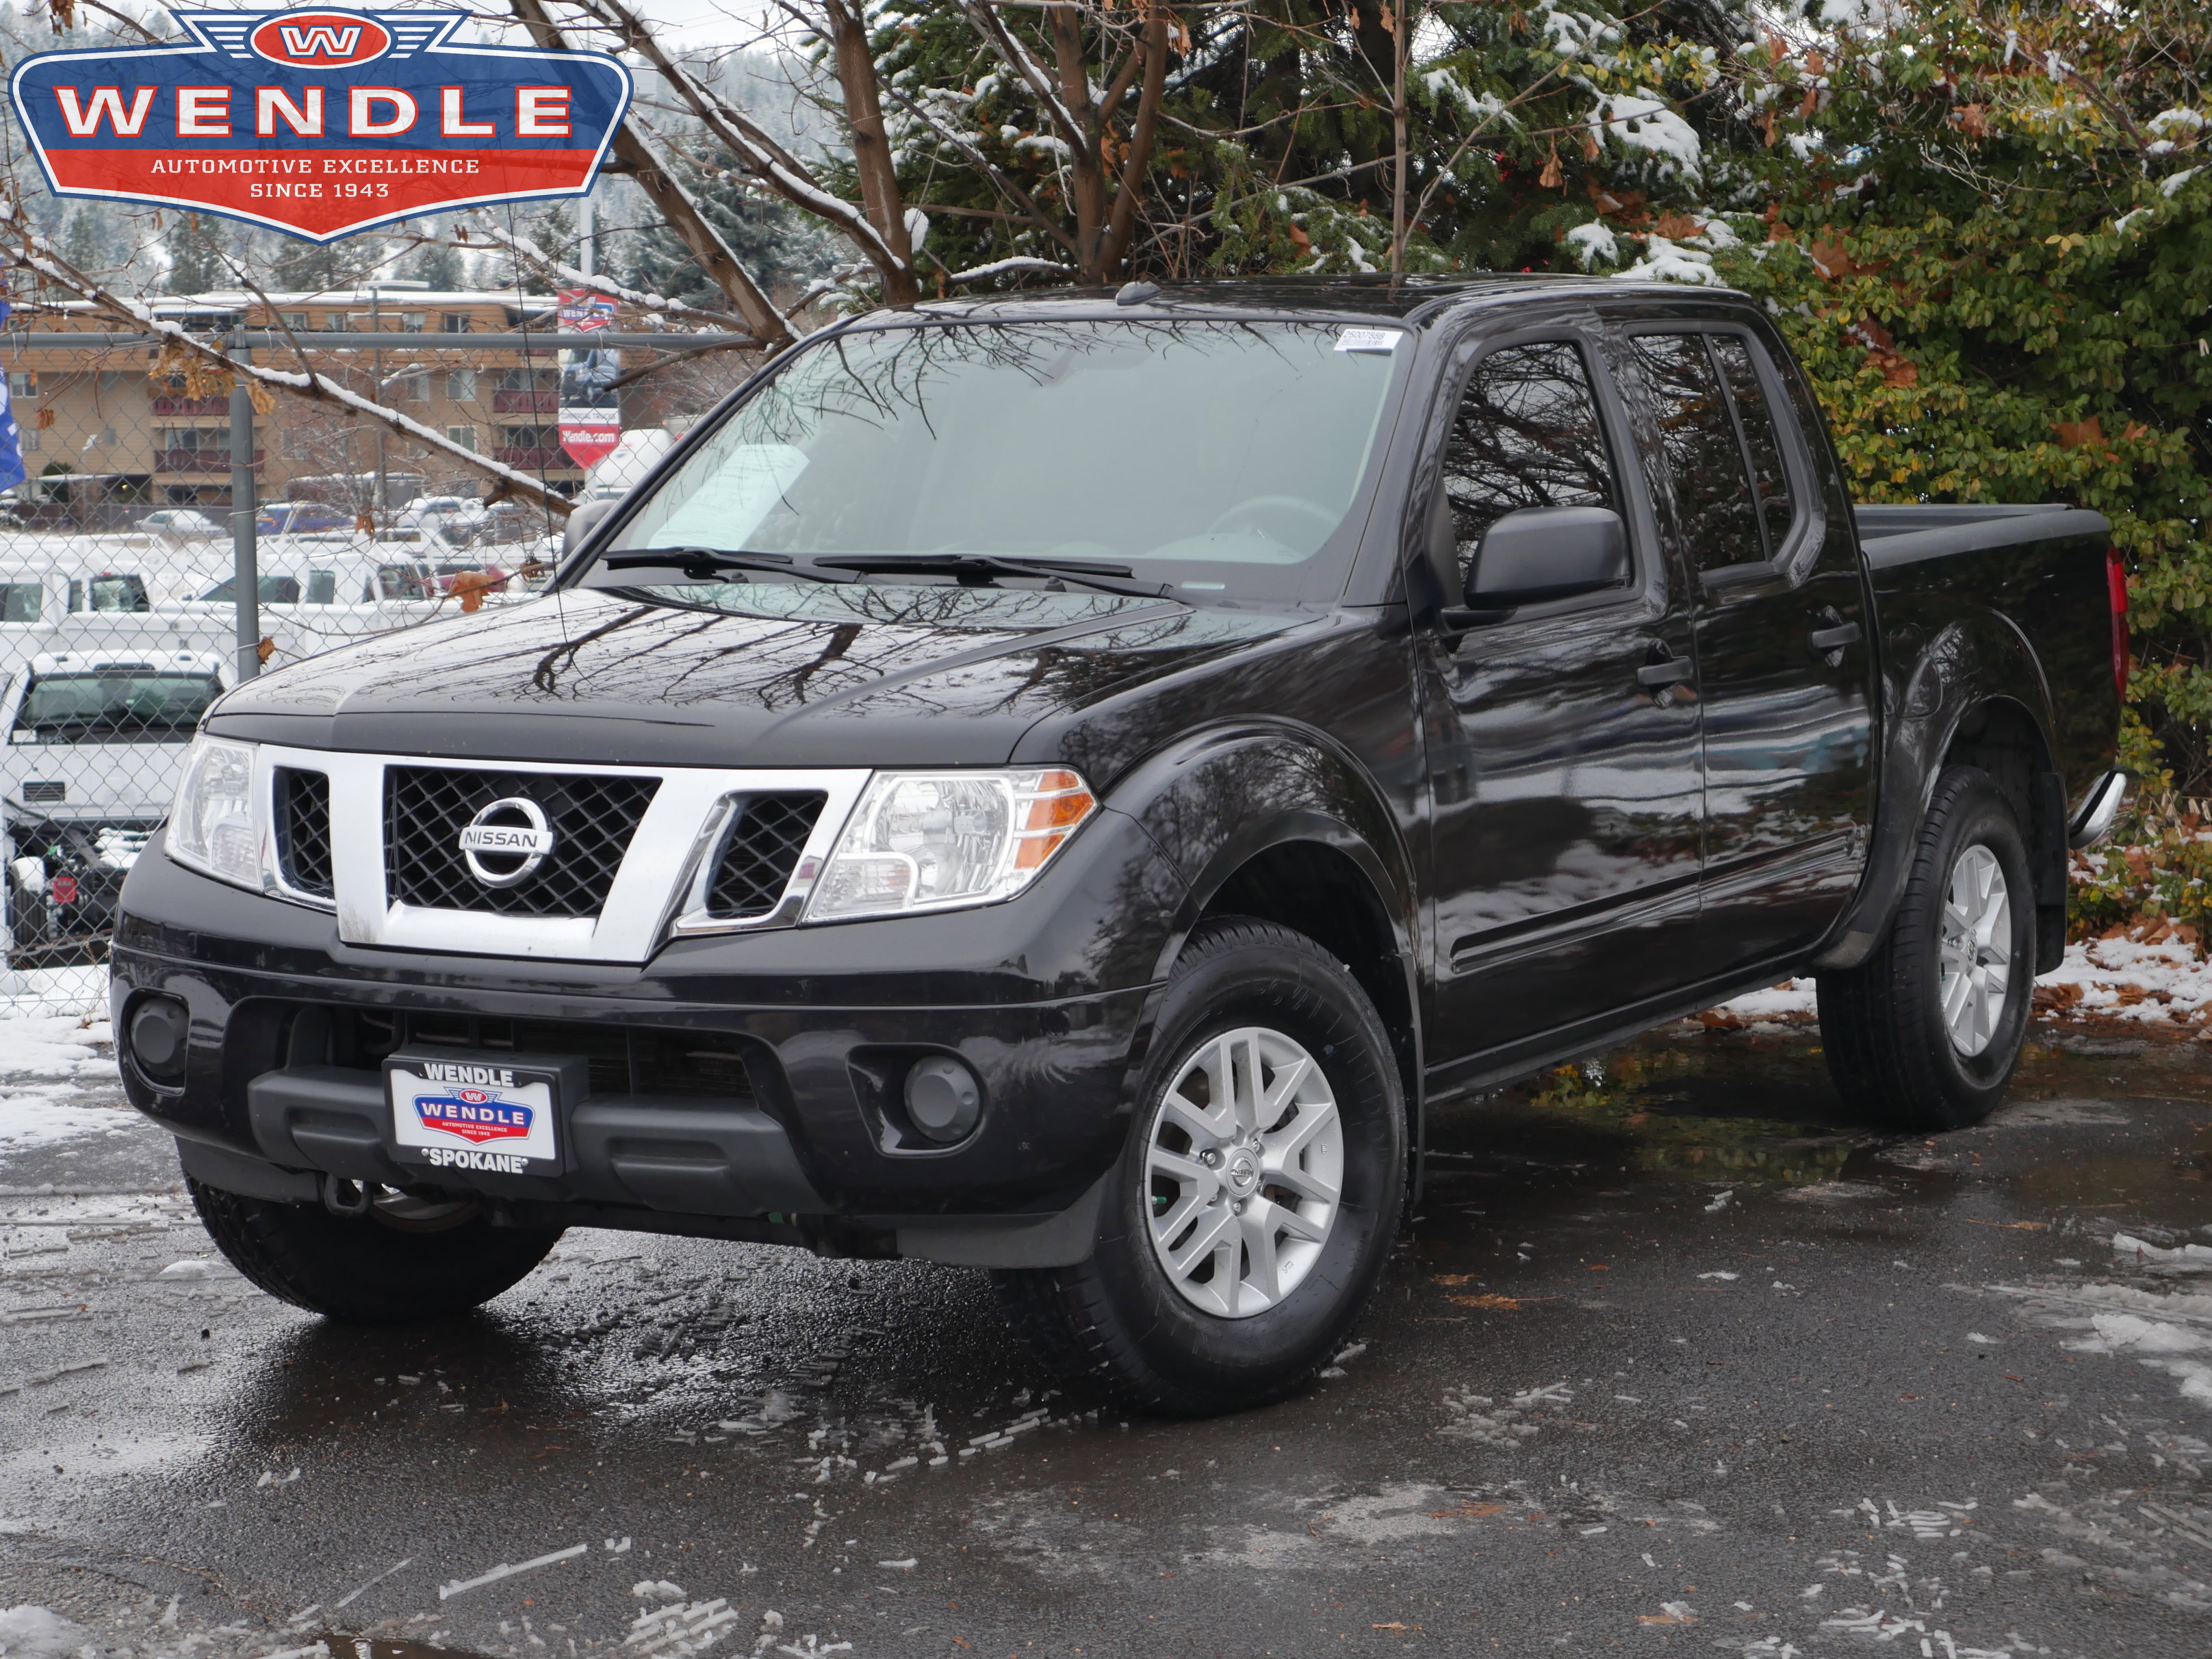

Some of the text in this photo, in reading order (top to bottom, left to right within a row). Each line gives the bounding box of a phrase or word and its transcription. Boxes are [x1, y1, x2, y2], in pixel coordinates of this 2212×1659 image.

[563, 430, 615, 443] Wendle.com
[464, 831, 538, 848] NISSAN
[424, 1063, 515, 1088] WENDLE
[421, 1103, 525, 1125] WENDLE
[441, 1121, 508, 1133] AUTOMOTIVE EXCELLENCE
[429, 1147, 524, 1174] SPOKANE
